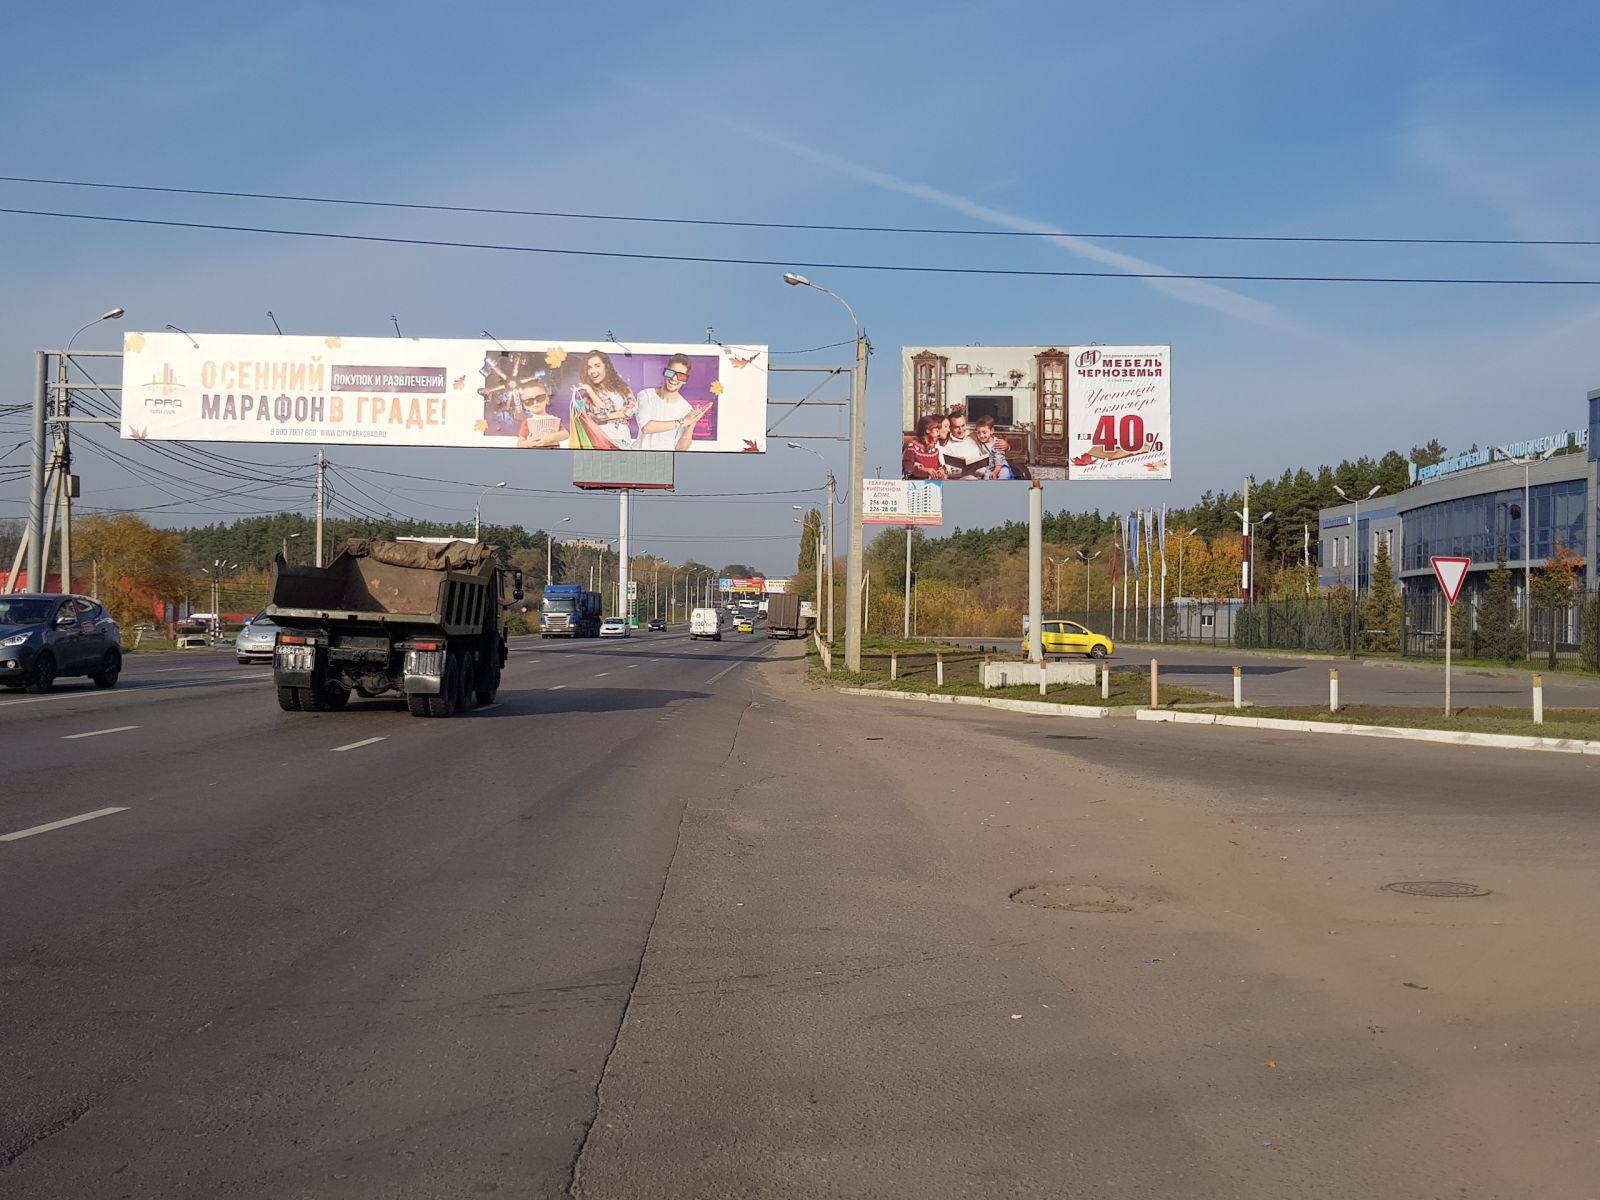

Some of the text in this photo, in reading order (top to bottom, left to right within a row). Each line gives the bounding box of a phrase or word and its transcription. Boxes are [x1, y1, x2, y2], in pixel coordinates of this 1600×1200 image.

[1102, 359, 1162, 368] МЕБЕЛЬ
[201, 355, 325, 391] ОСЕННИЙ
[1077, 368, 1162, 378] ЧЕРНОЗЕМЬЯ
[333, 374, 445, 387] ПОКУПОК И РАЗВЛЕЧЕНИЙ
[144, 398, 183, 408] ГРАД
[201, 393, 447, 430] МАРАФОН В ГРАДЕ!
[1493, 430, 1569, 461] ООЛОГИЧЕСКИЙ
